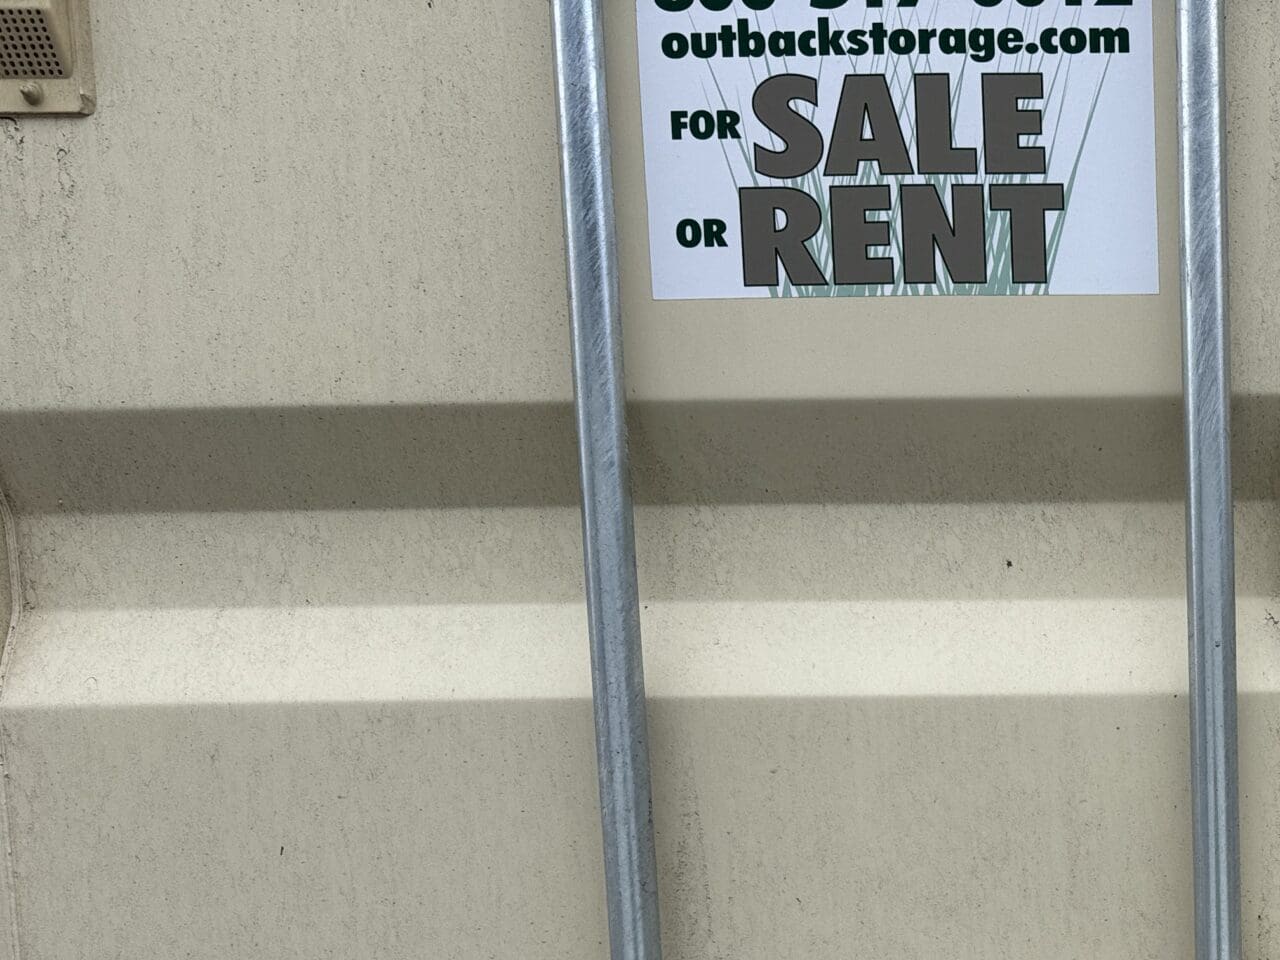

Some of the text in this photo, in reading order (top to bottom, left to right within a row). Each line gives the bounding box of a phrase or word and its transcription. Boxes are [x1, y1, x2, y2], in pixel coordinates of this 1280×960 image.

[661, 16, 1130, 63] outbackstorage.com
[670, 71, 1047, 180] FOR SALE
[676, 182, 1065, 288] OR RENT
